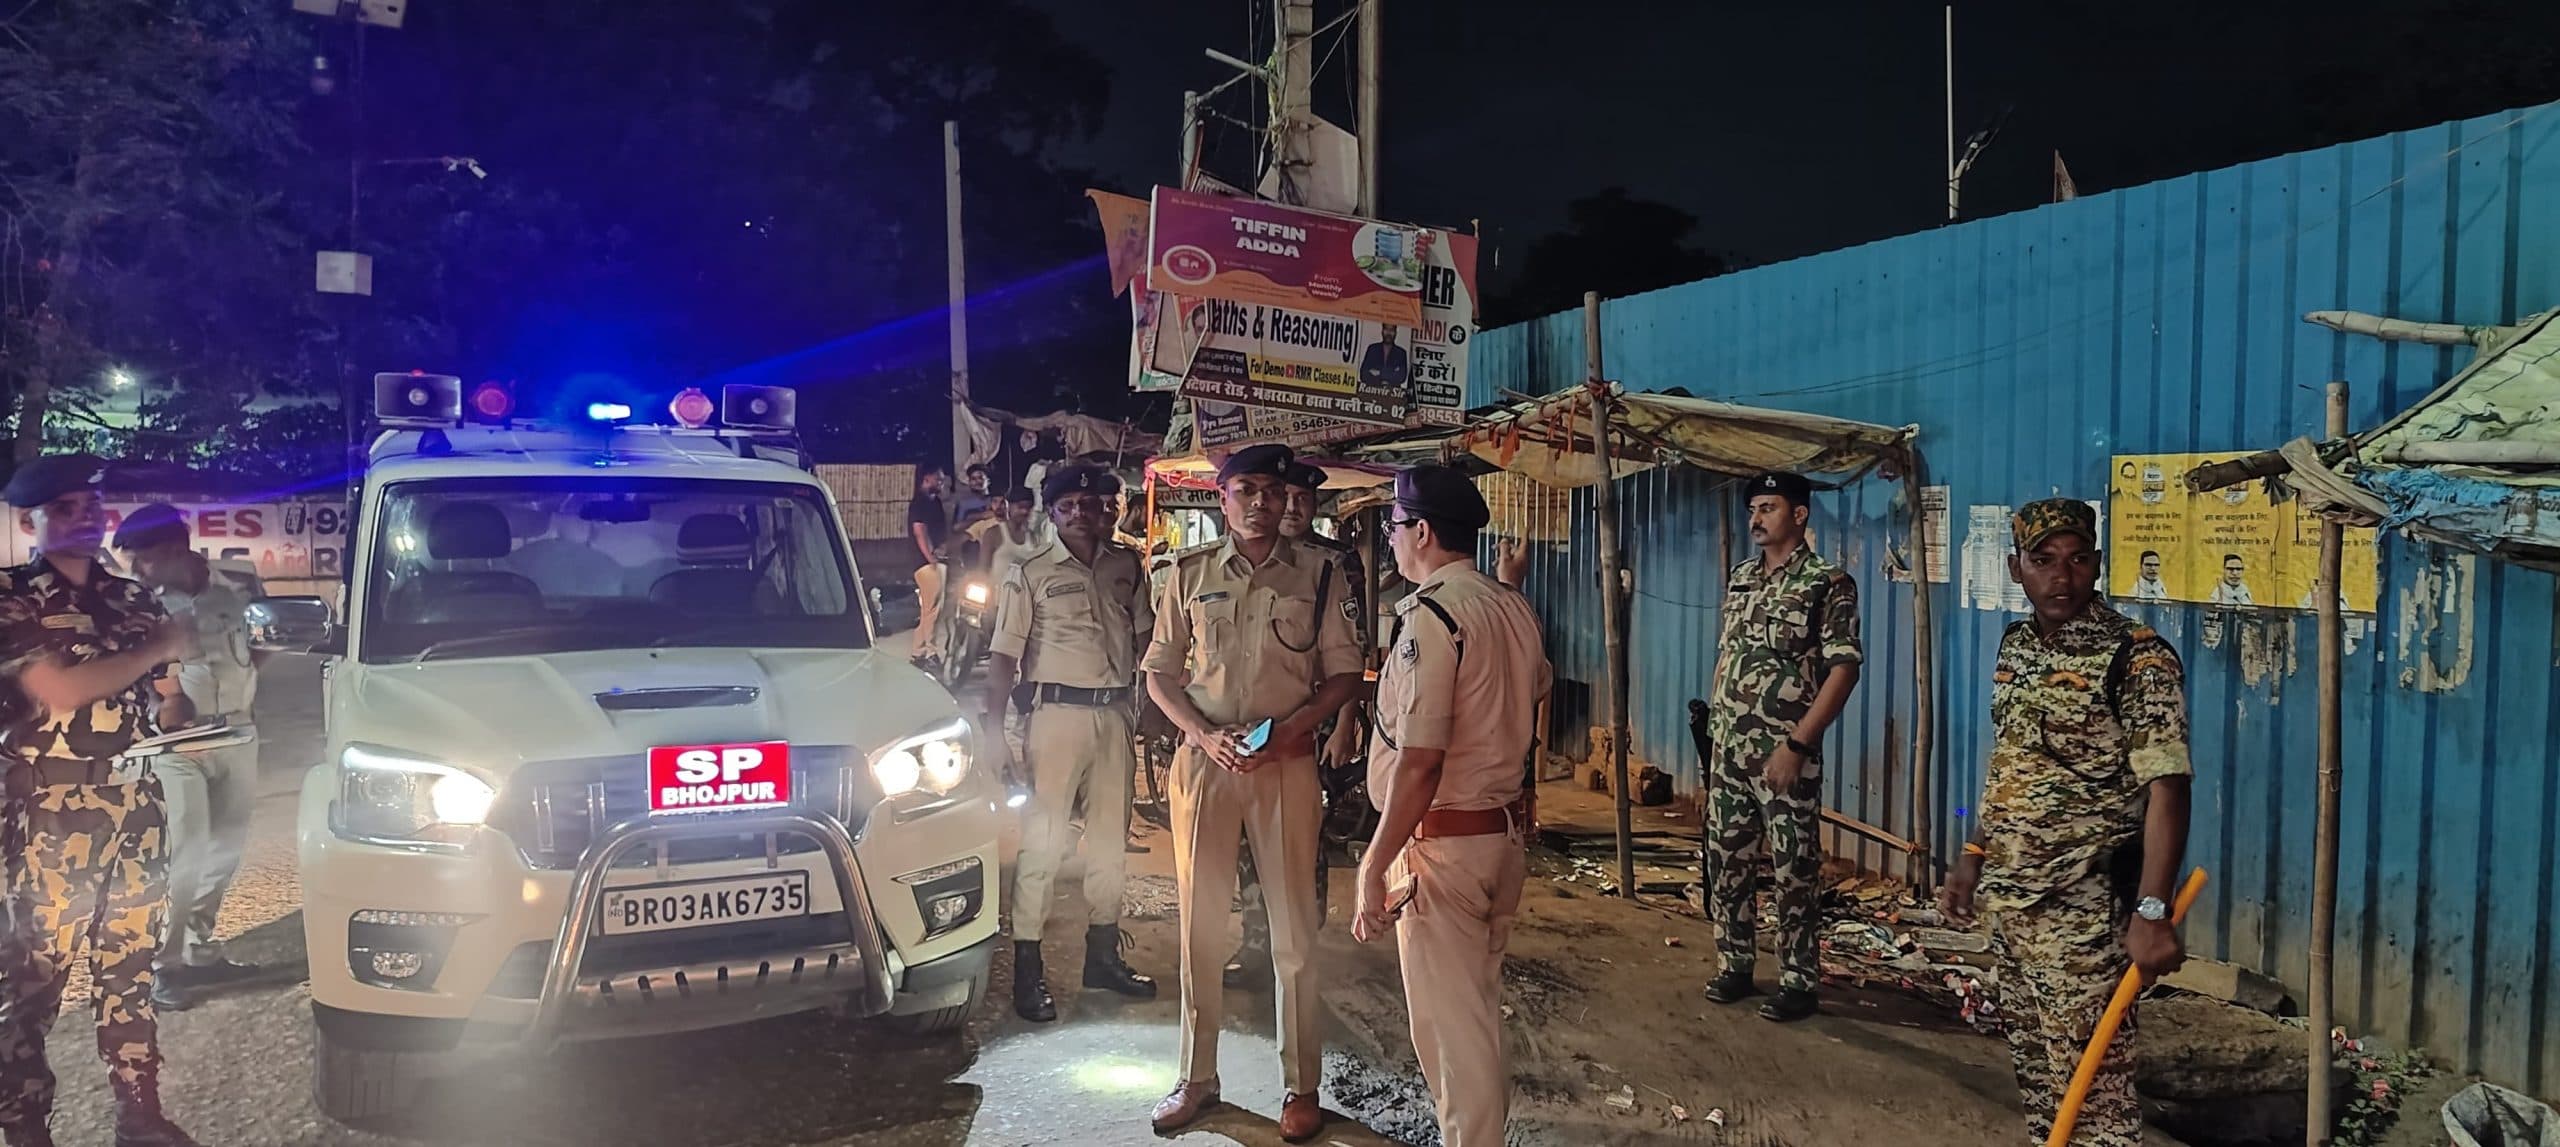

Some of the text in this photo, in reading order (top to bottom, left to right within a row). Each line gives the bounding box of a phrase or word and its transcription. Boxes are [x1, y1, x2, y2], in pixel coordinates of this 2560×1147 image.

[1231, 216, 1307, 243] TIFFIN
[1236, 237, 1301, 258] ADDA
[1308, 281, 1342, 292] Monthly
[1252, 305, 1265, 339] &
[1270, 307, 1359, 364] Reasoning)
[1452, 327, 1464, 341] के
[1250, 358, 1263, 373] For
[1264, 360, 1285, 377] Demo
[1295, 364, 1312, 381] RMR
[1313, 367, 1341, 385] Classes
[1343, 371, 1355, 386] Ara
[1185, 375, 1222, 394] स्टेशन
[1224, 380, 1248, 400] रोड,
[1252, 386, 1304, 406] महाराजा
[1335, 396, 1362, 413] गली
[1391, 404, 1405, 419] 02
[1358, 382, 1390, 395] Ranvir
[1390, 387, 1406, 398] Sir
[676, 748, 763, 783] SP
[661, 781, 776, 806] BHOJPUR
[624, 884, 803, 927] BR03AK6735
